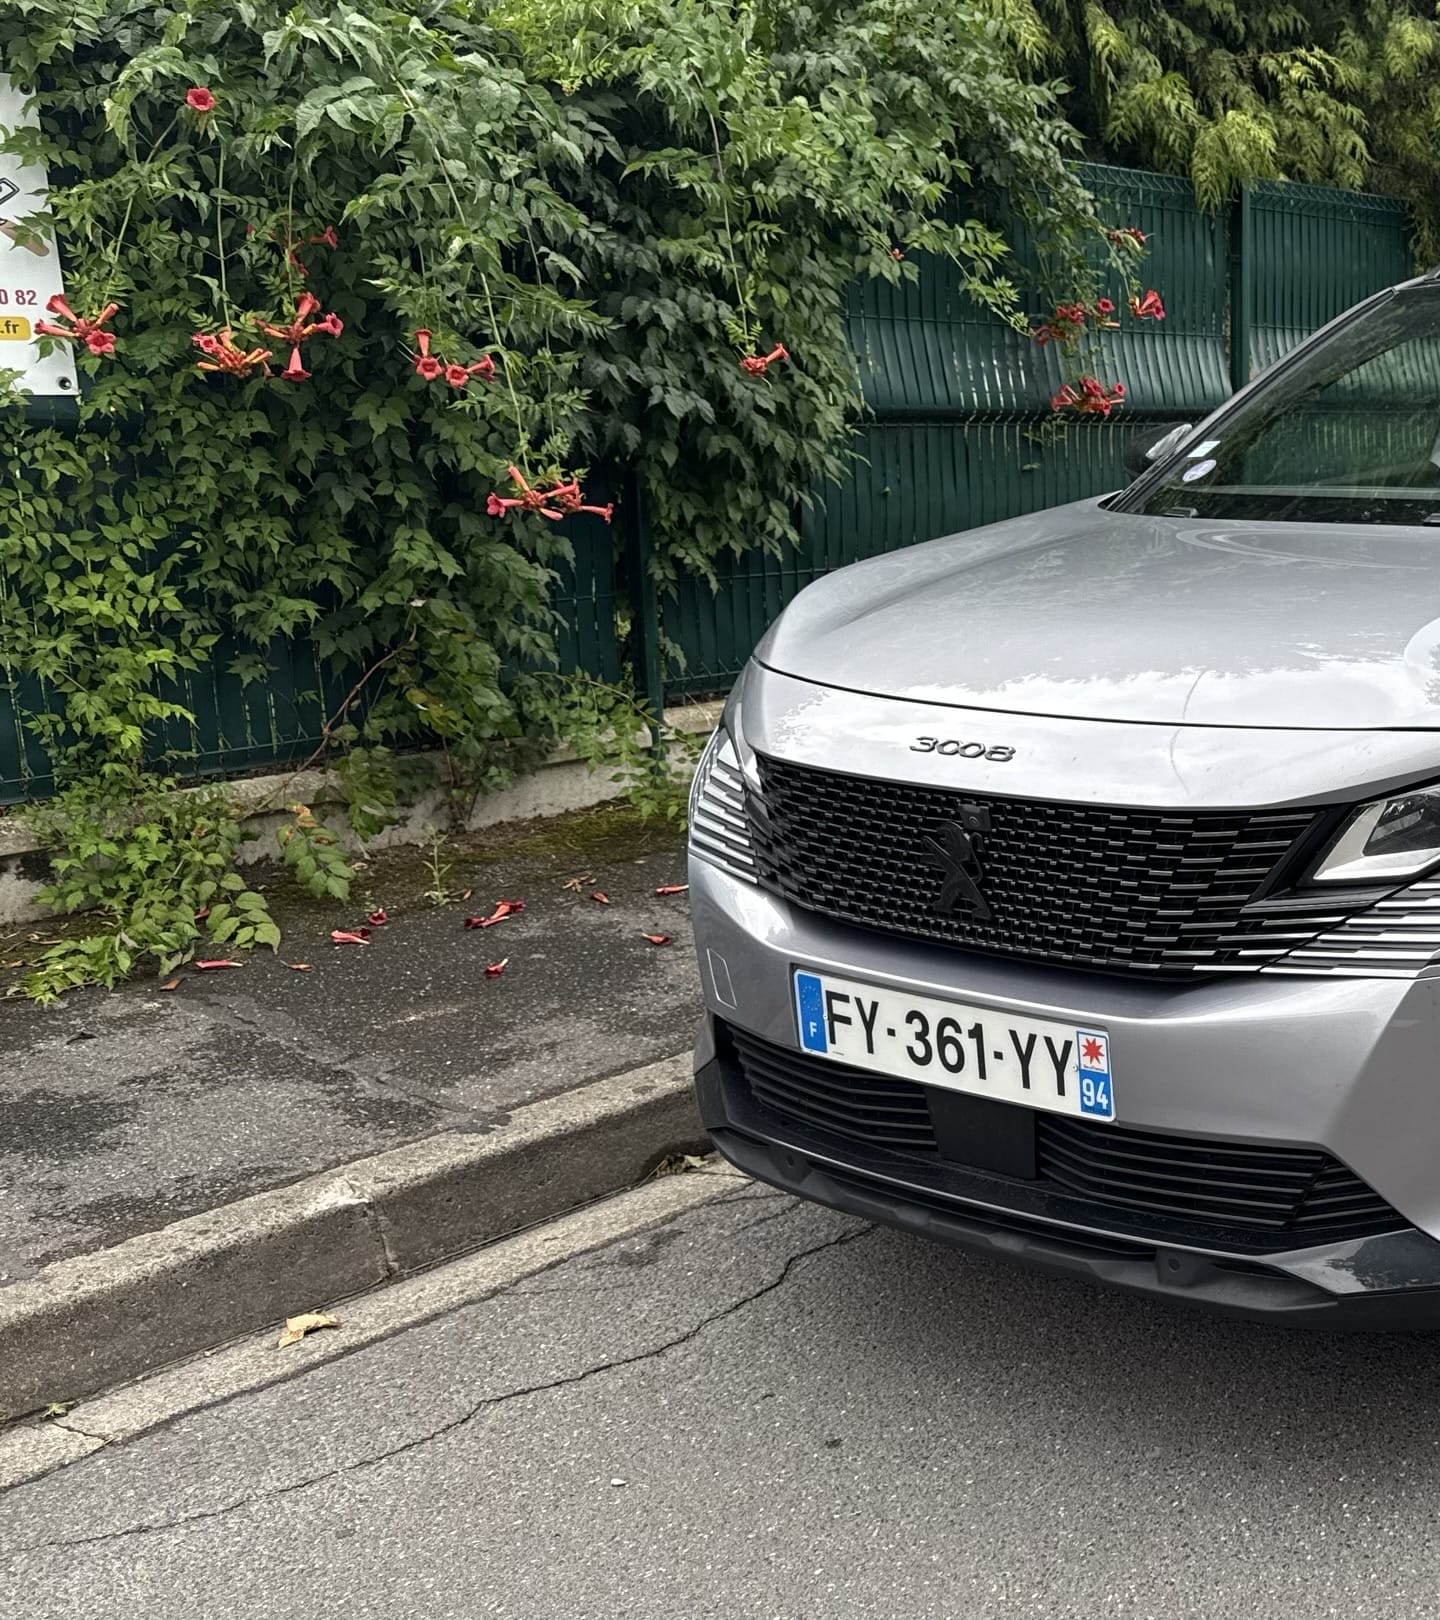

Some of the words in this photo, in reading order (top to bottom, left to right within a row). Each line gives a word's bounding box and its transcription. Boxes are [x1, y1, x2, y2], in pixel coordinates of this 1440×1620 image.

[15, 289, 38, 305] 82
[909, 736, 1017, 763] 3008
[809, 1021, 818, 1038] F
[825, 989, 1074, 1097] FY-361-YY
[1082, 1078, 1109, 1110] 94
